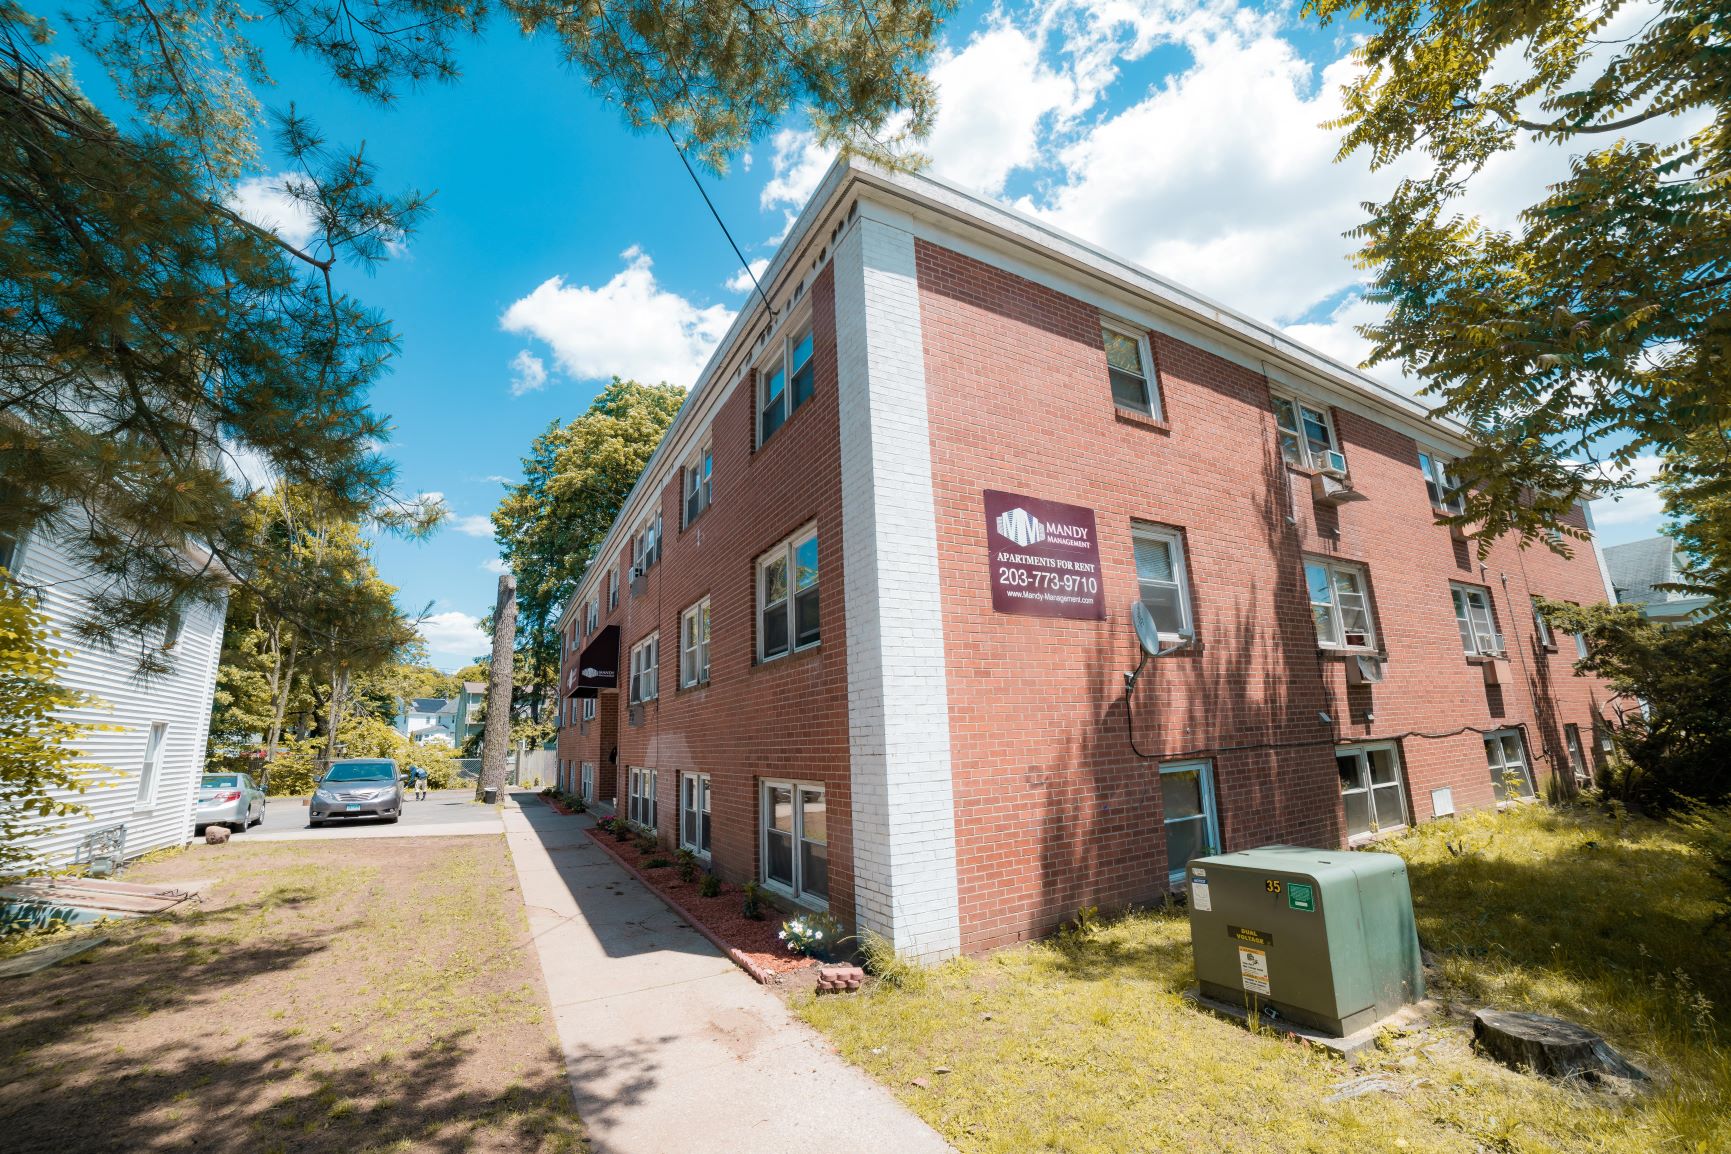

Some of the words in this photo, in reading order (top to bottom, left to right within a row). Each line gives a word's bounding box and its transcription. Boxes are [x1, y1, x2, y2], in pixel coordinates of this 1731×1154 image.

[1046, 521, 1088, 539] MANDY
[1047, 535, 1090, 548] MANAGEMENT
[997, 552, 1056, 568] APARTMENTS
[1057, 560, 1073, 571] FOR
[1074, 562, 1095, 573] RENT
[999, 567, 1097, 594] 203-773-9710
[1006, 590, 1094, 604] www.Mandy-Management.com
[1266, 880, 1280, 893] 35
[1240, 928, 1257, 936] DUAL
